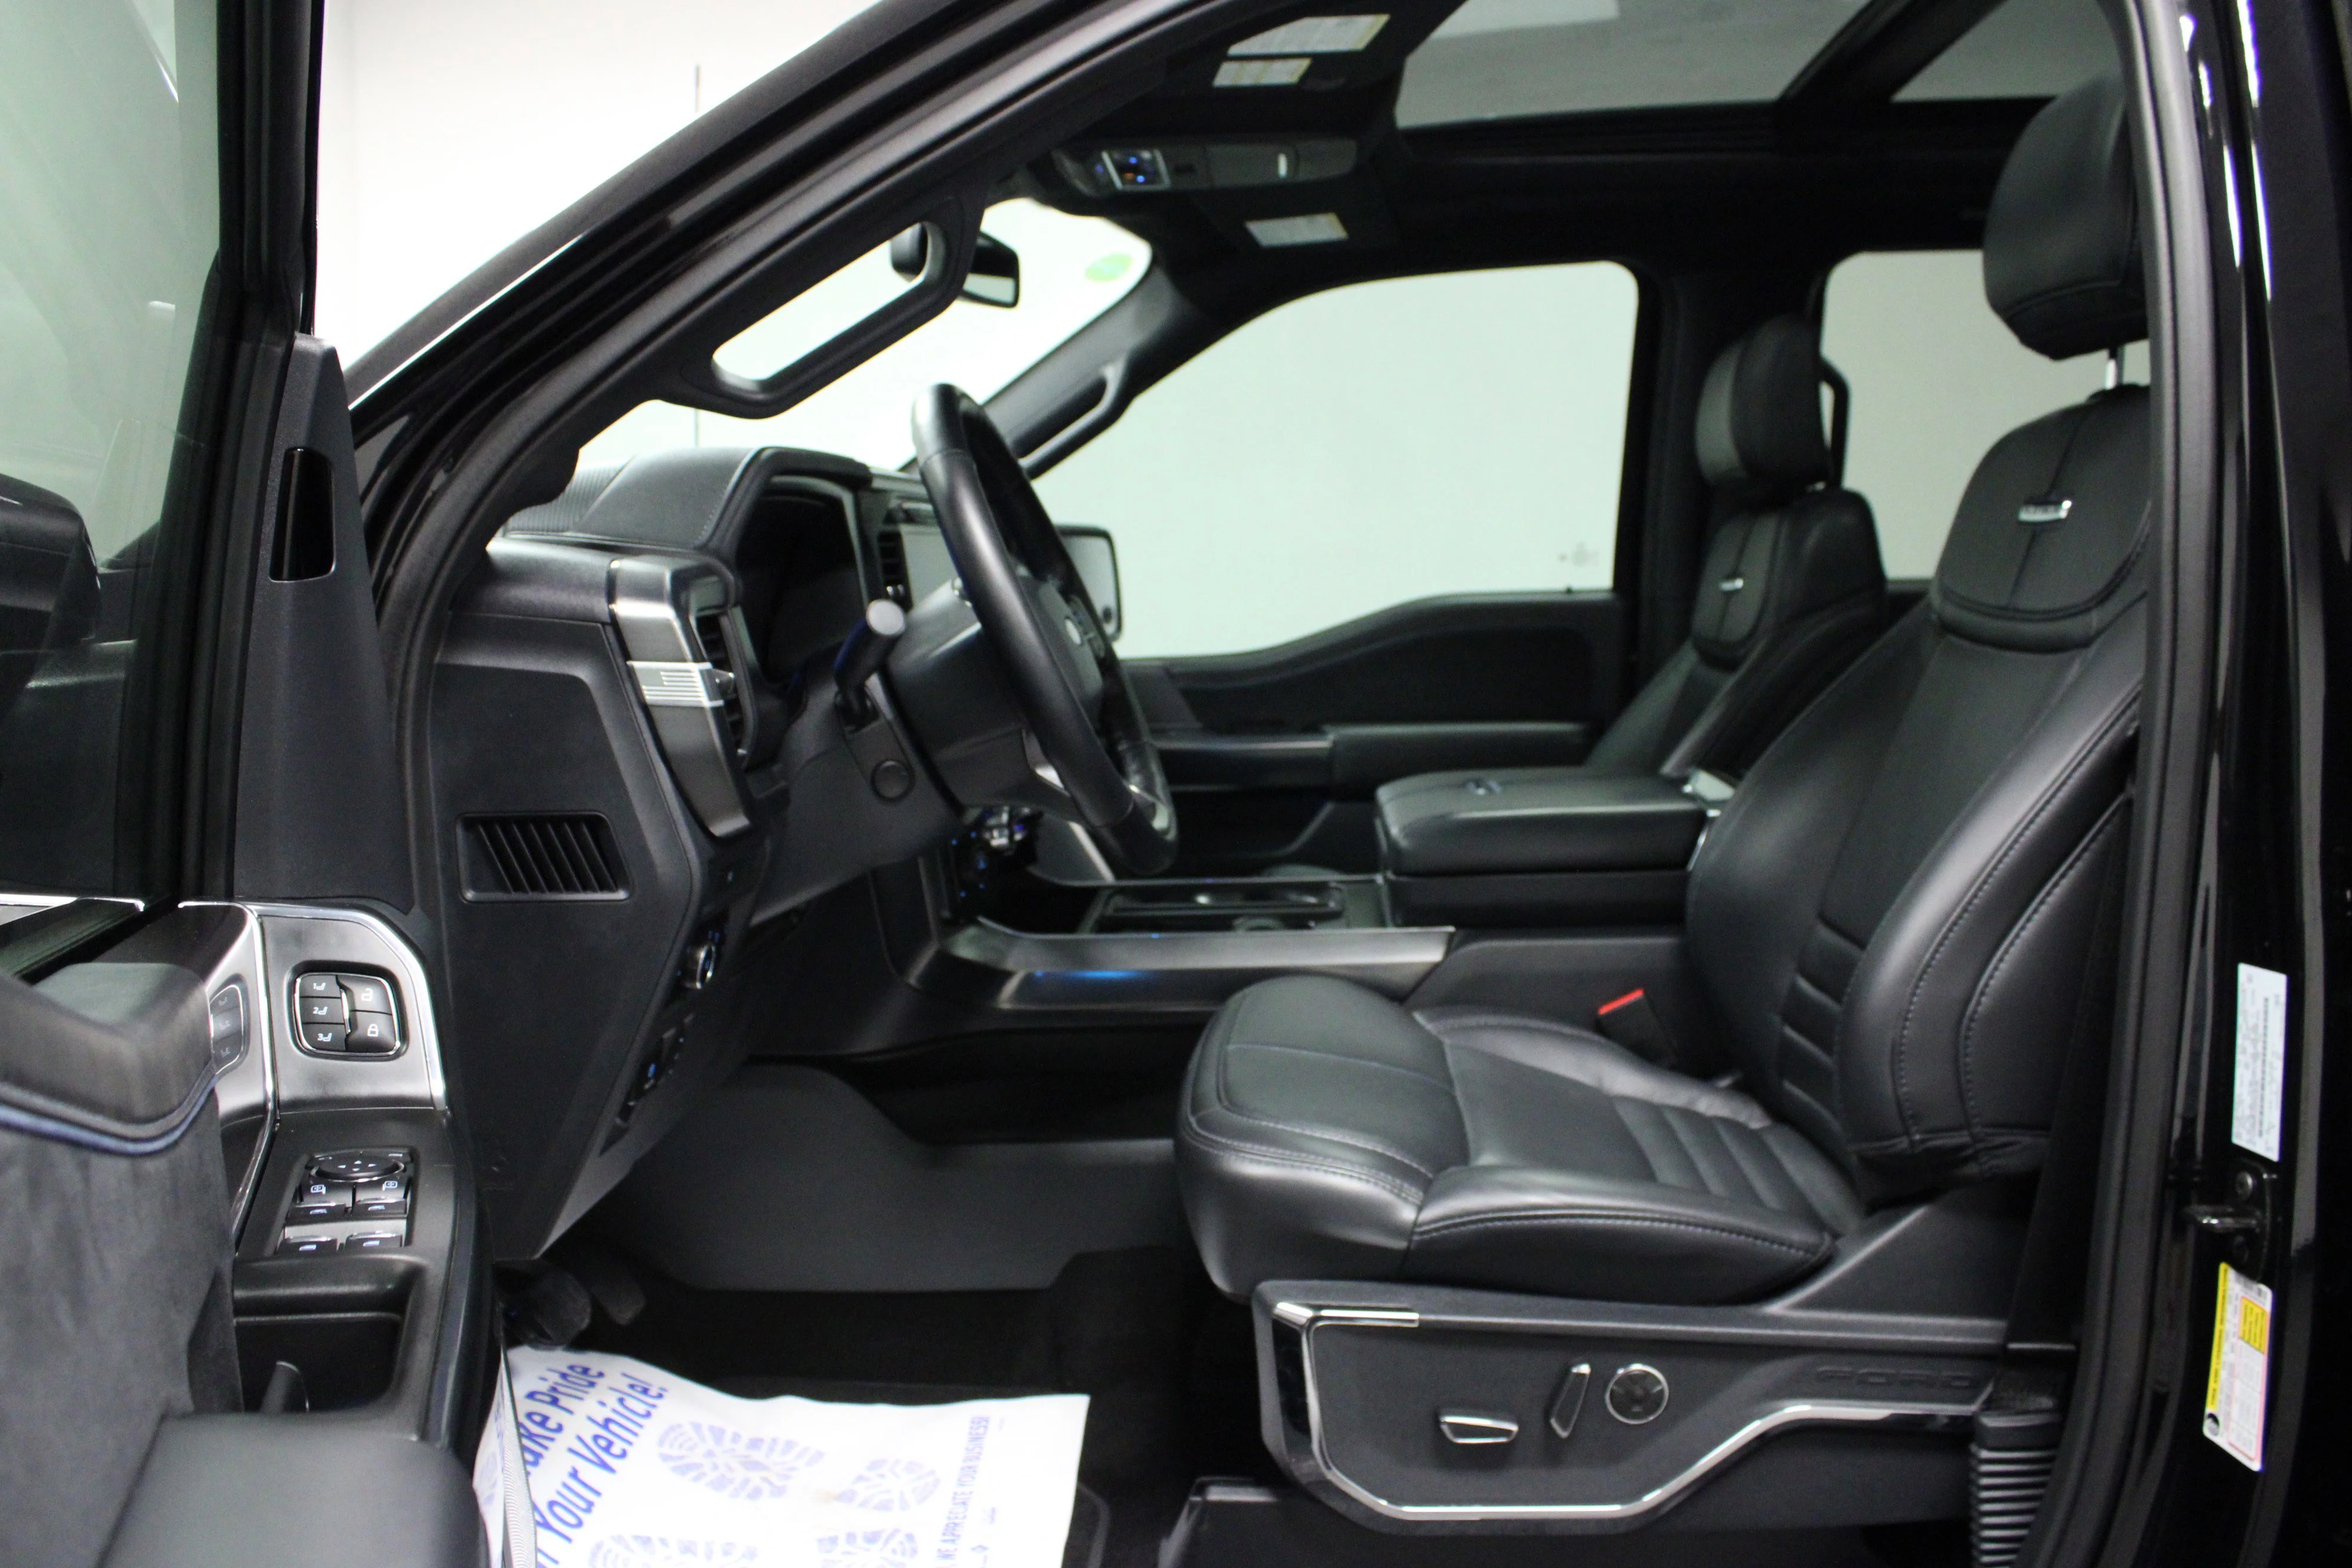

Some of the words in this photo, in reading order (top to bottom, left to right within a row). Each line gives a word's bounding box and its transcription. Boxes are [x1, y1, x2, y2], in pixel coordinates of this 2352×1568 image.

[524, 1364, 604, 1415] Pride
[519, 1412, 563, 1475] ake
[567, 1373, 668, 1474] Vehicle!
[956, 1464, 978, 1487] YOUR
[533, 1466, 602, 1544] Your
[940, 1491, 973, 1544] APPRECIATE
[936, 1548, 958, 1560] WE
